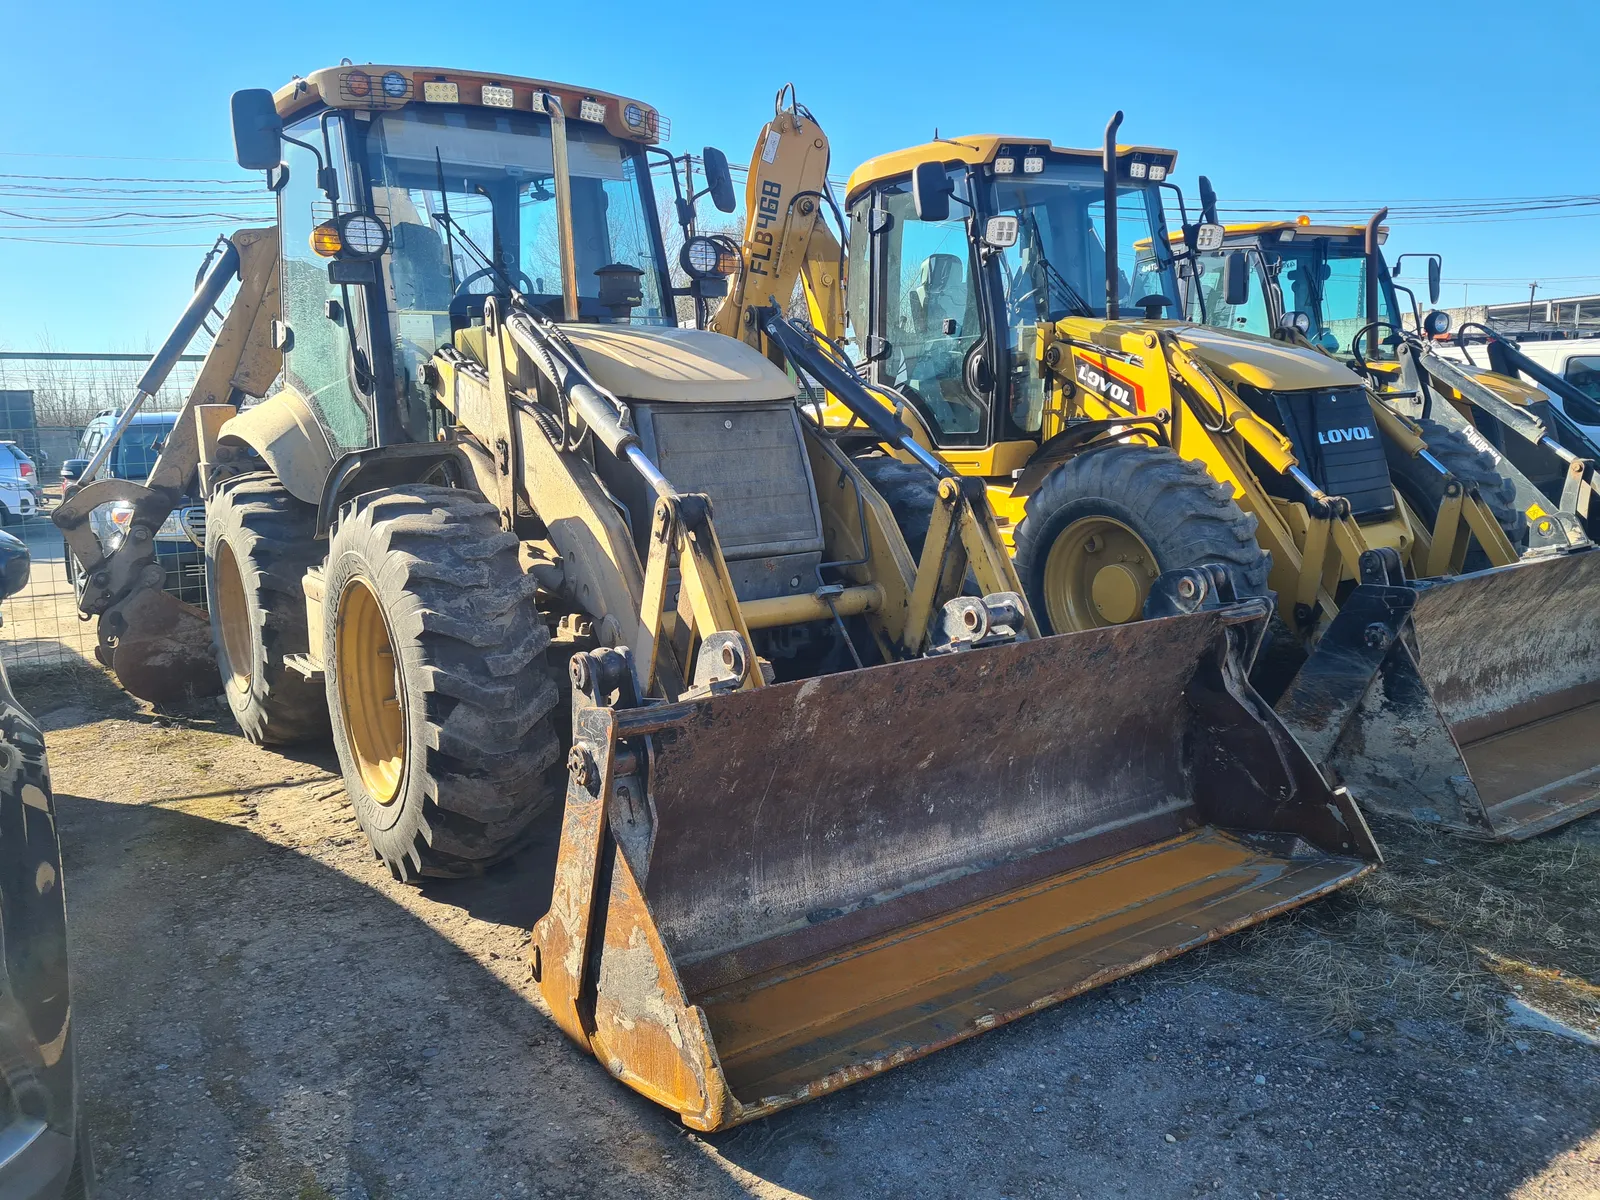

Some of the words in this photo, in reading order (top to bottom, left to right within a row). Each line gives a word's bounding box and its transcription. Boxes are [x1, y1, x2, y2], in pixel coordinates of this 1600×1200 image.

[750, 180, 782, 276] FLB468
[1078, 365, 1131, 406] LOVOL
[1317, 426, 1375, 445] LOVOL
